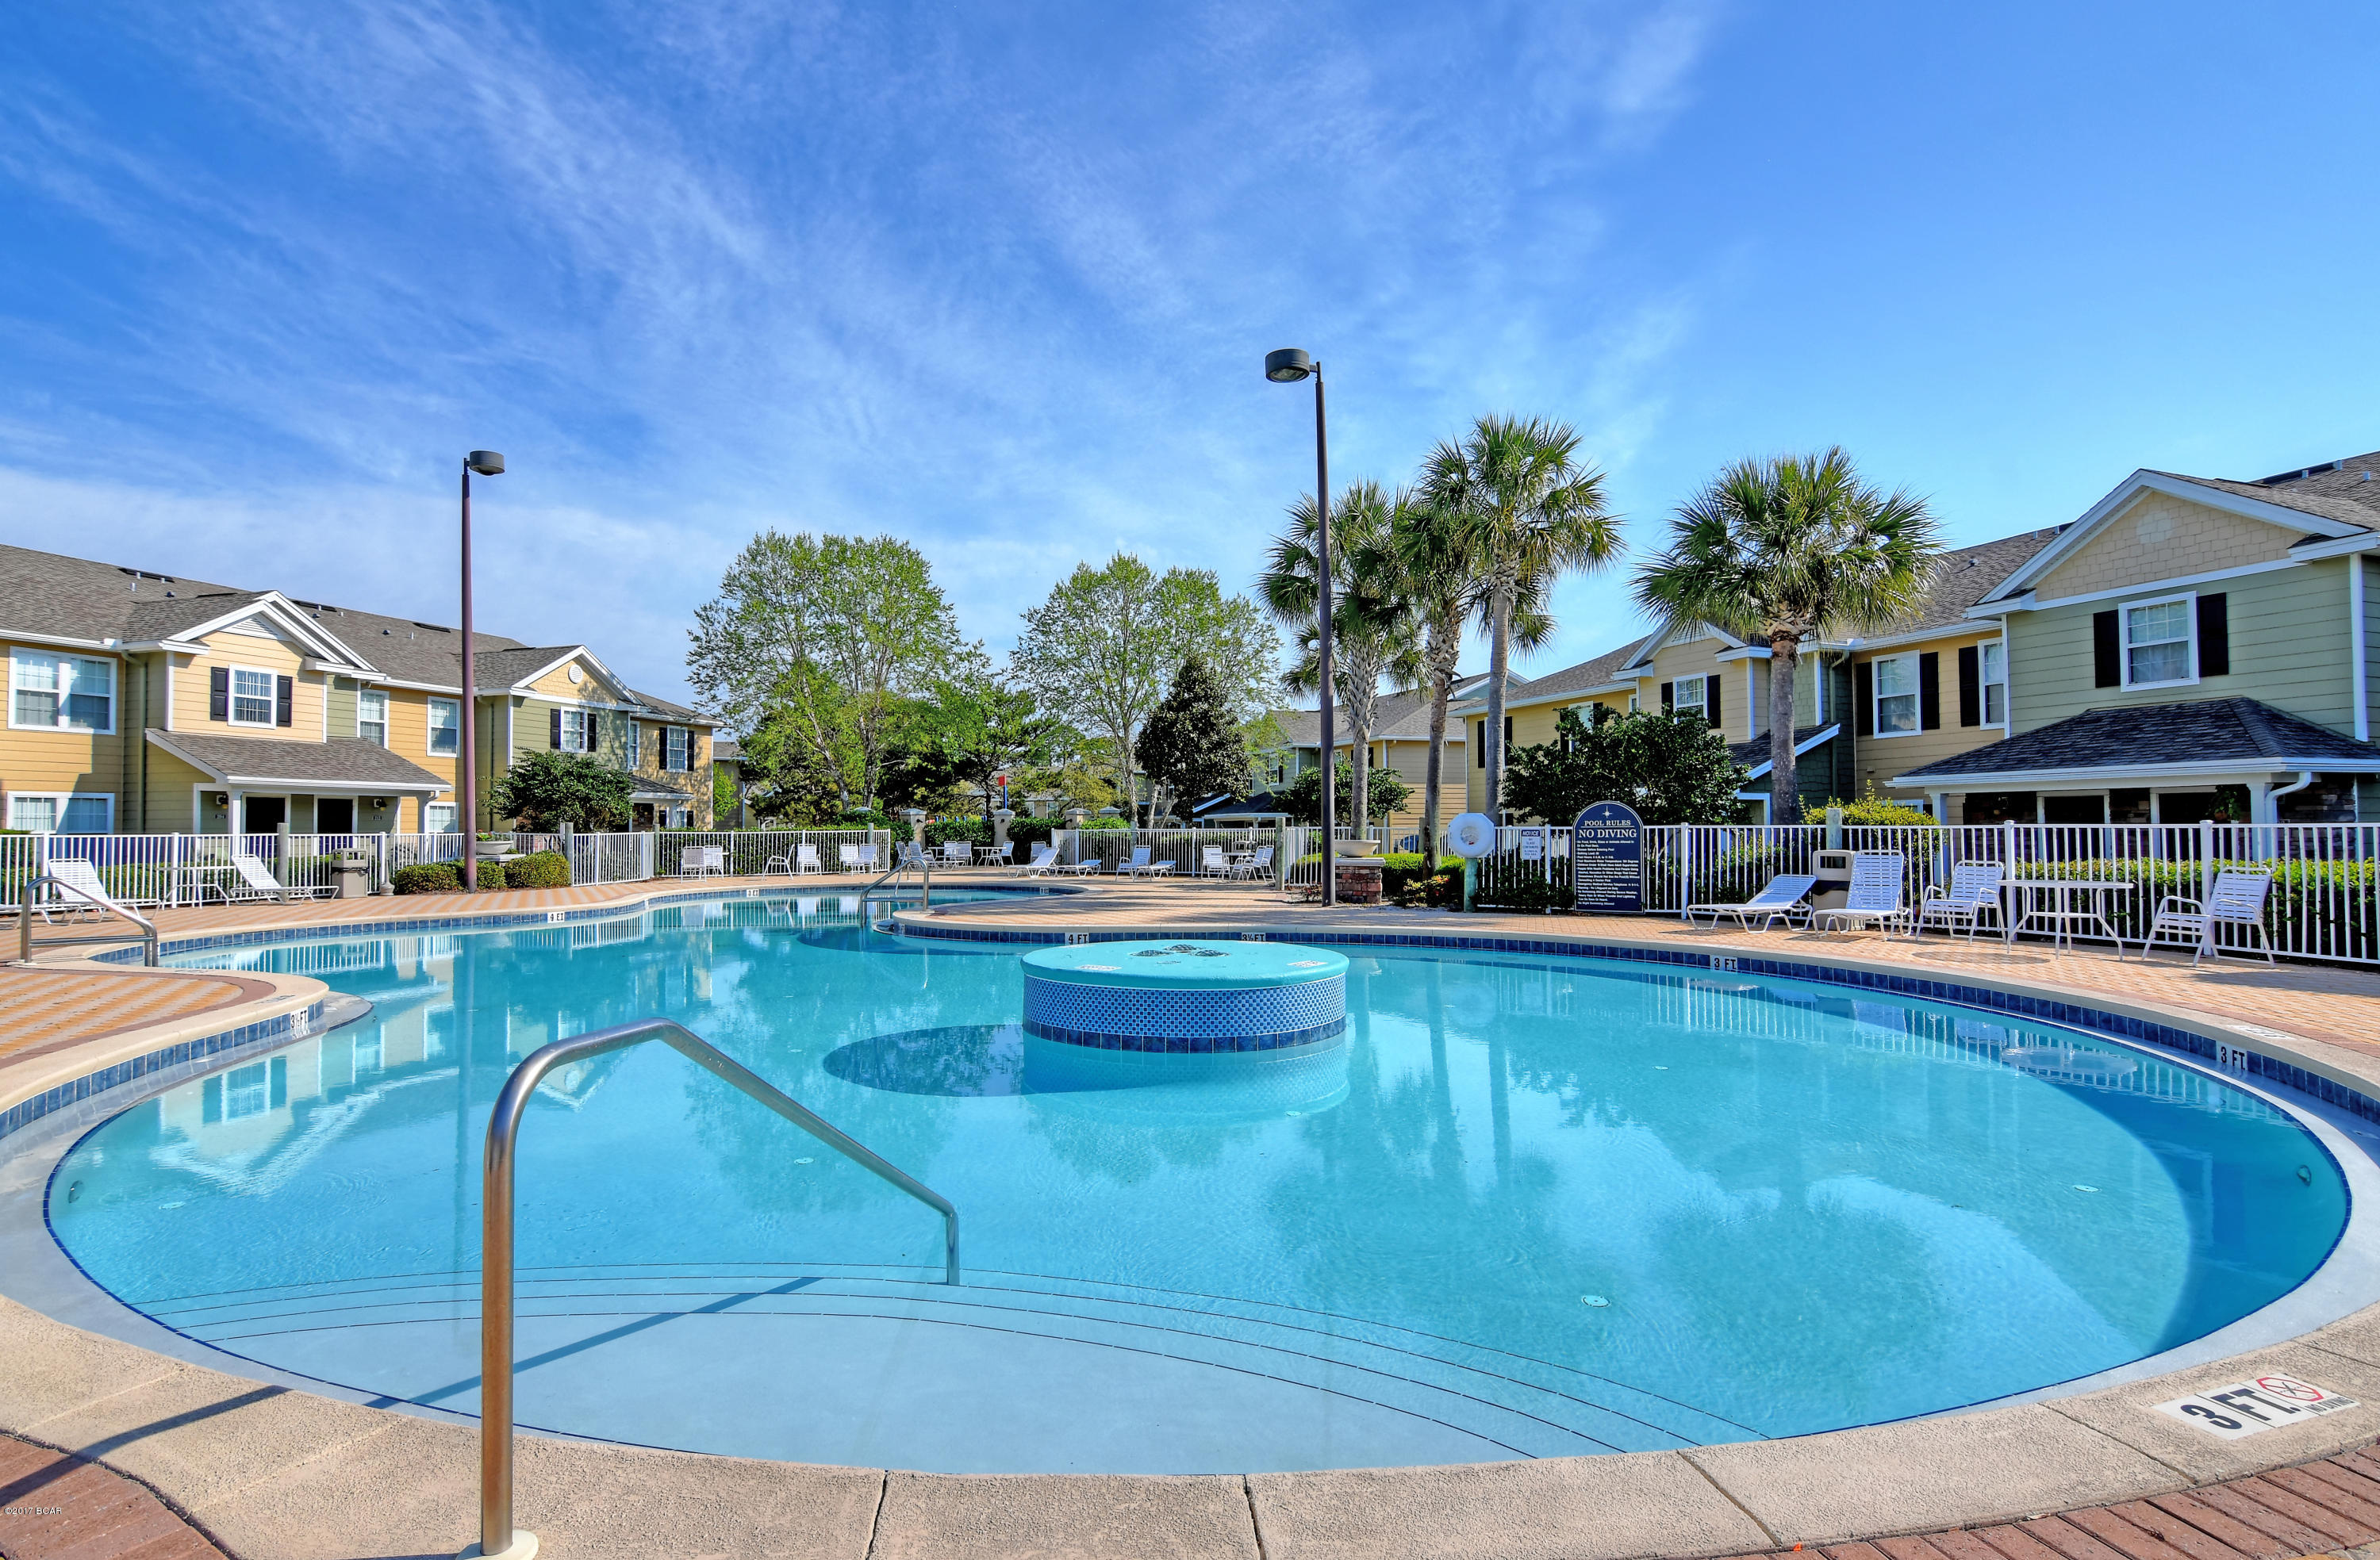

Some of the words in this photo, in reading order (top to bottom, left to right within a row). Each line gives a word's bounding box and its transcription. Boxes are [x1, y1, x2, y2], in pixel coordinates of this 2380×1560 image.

[1578, 829, 1595, 838] NO
[1597, 829, 1637, 838] DIVING
[1068, 933, 1073, 945] 4
[1714, 957, 1720, 968] 3
[2221, 1046, 2228, 1064] 3
[2305, 1404, 2328, 1413] NO
[2317, 1397, 2355, 1409] DIVING
[2180, 1404, 2243, 1430] 3
